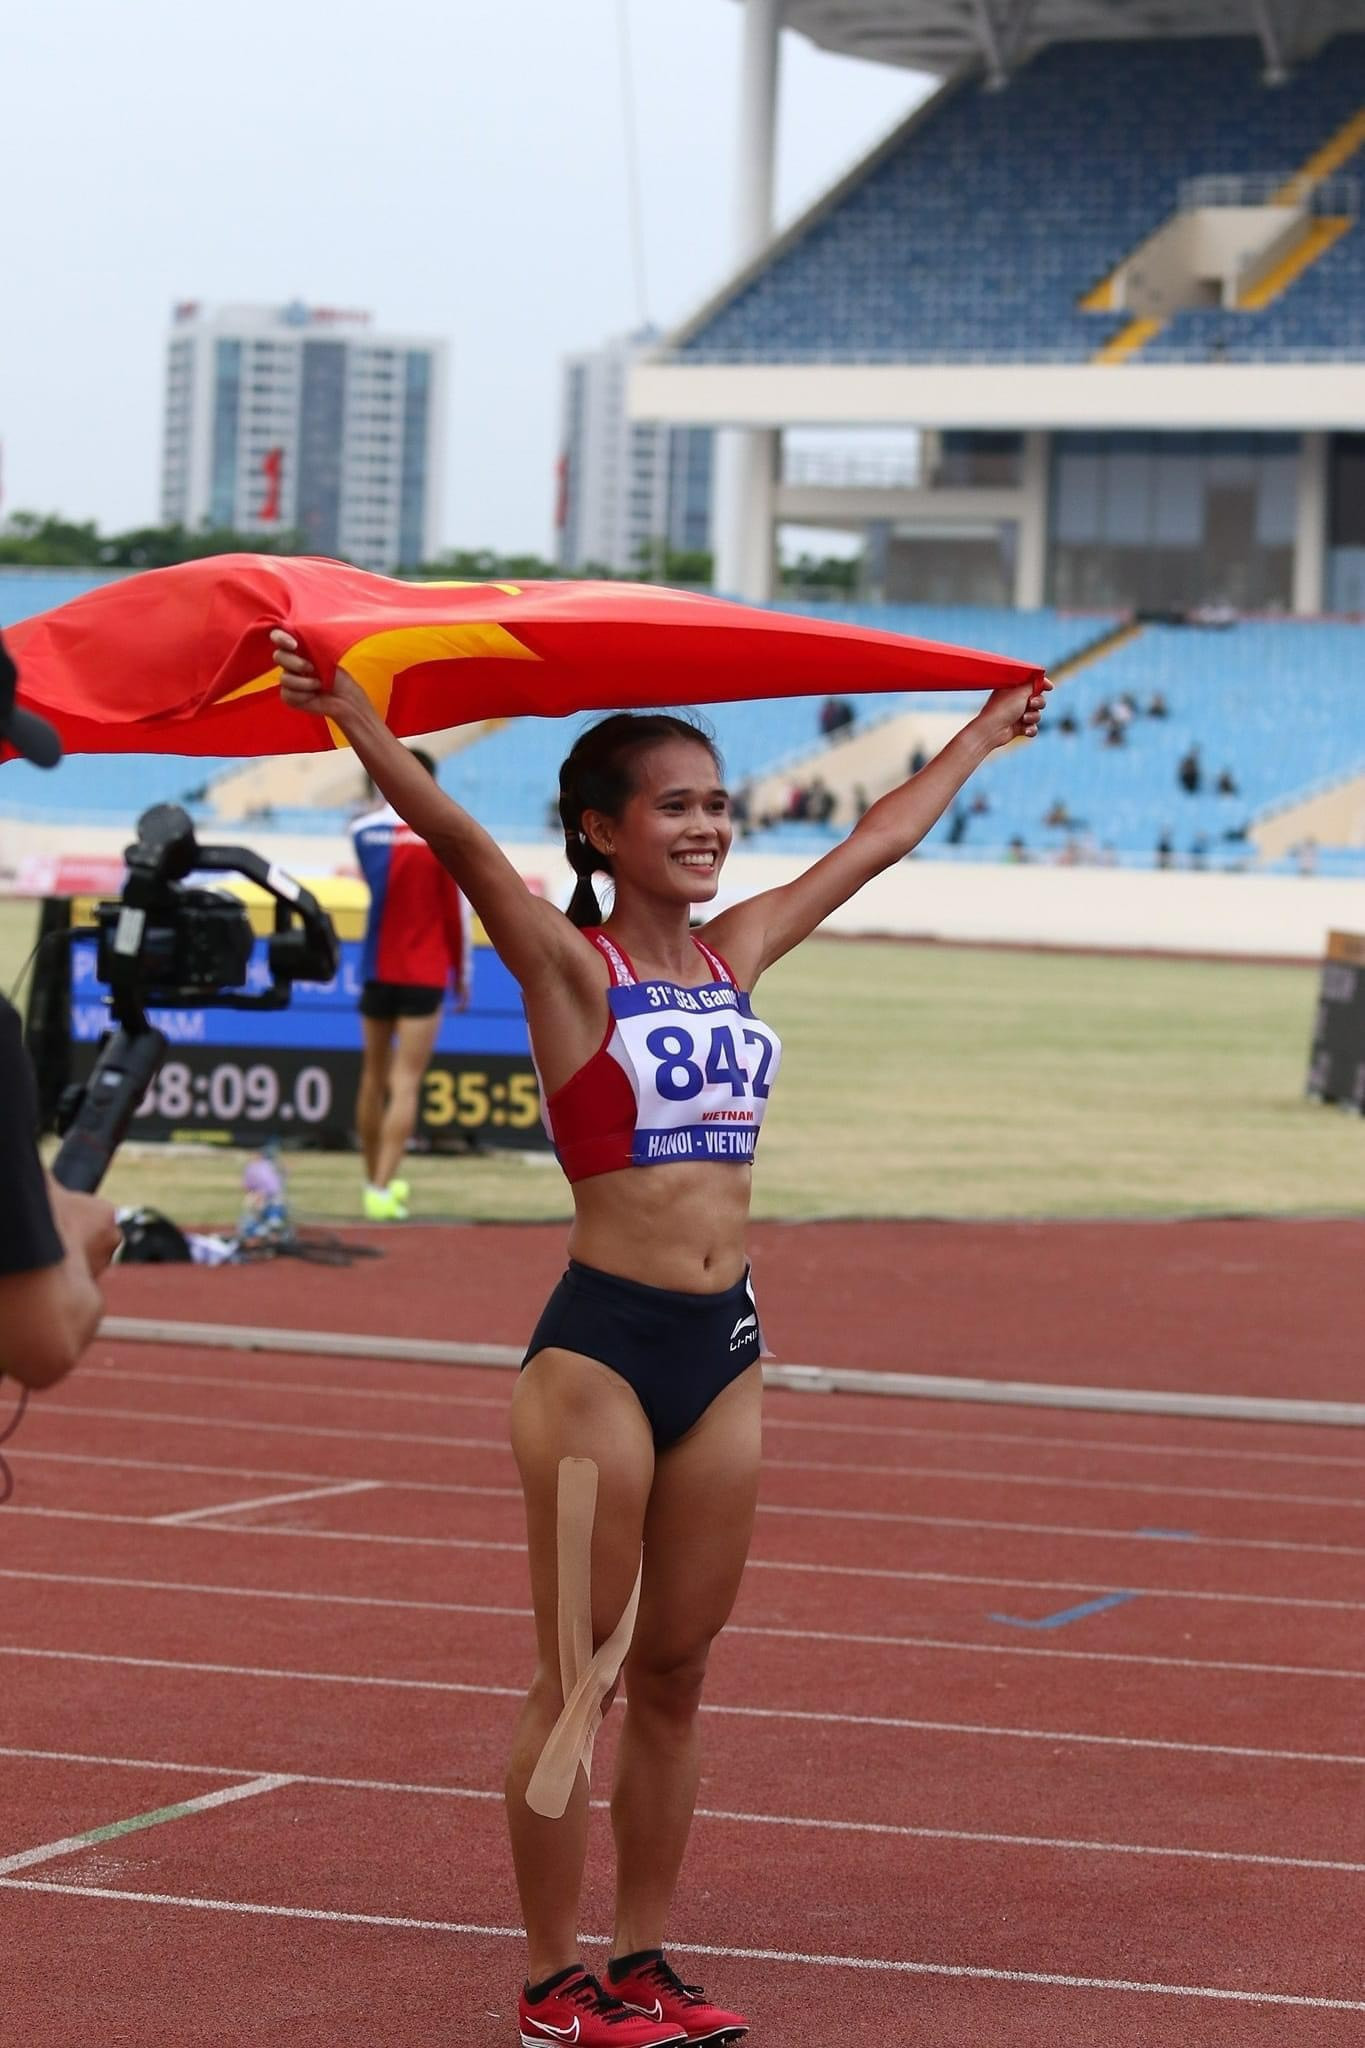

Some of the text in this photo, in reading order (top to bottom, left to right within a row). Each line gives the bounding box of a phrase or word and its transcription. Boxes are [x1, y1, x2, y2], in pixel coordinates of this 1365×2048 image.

[674, 988, 702, 1010] SEA
[699, 988, 739, 1009] Game
[646, 1025, 773, 1101] 842
[423, 1070, 540, 1129] 35:5
[648, 1131, 692, 1157] HANOI
[705, 1131, 754, 1153] VIETNA
[730, 1329, 757, 1351] LI-NI
